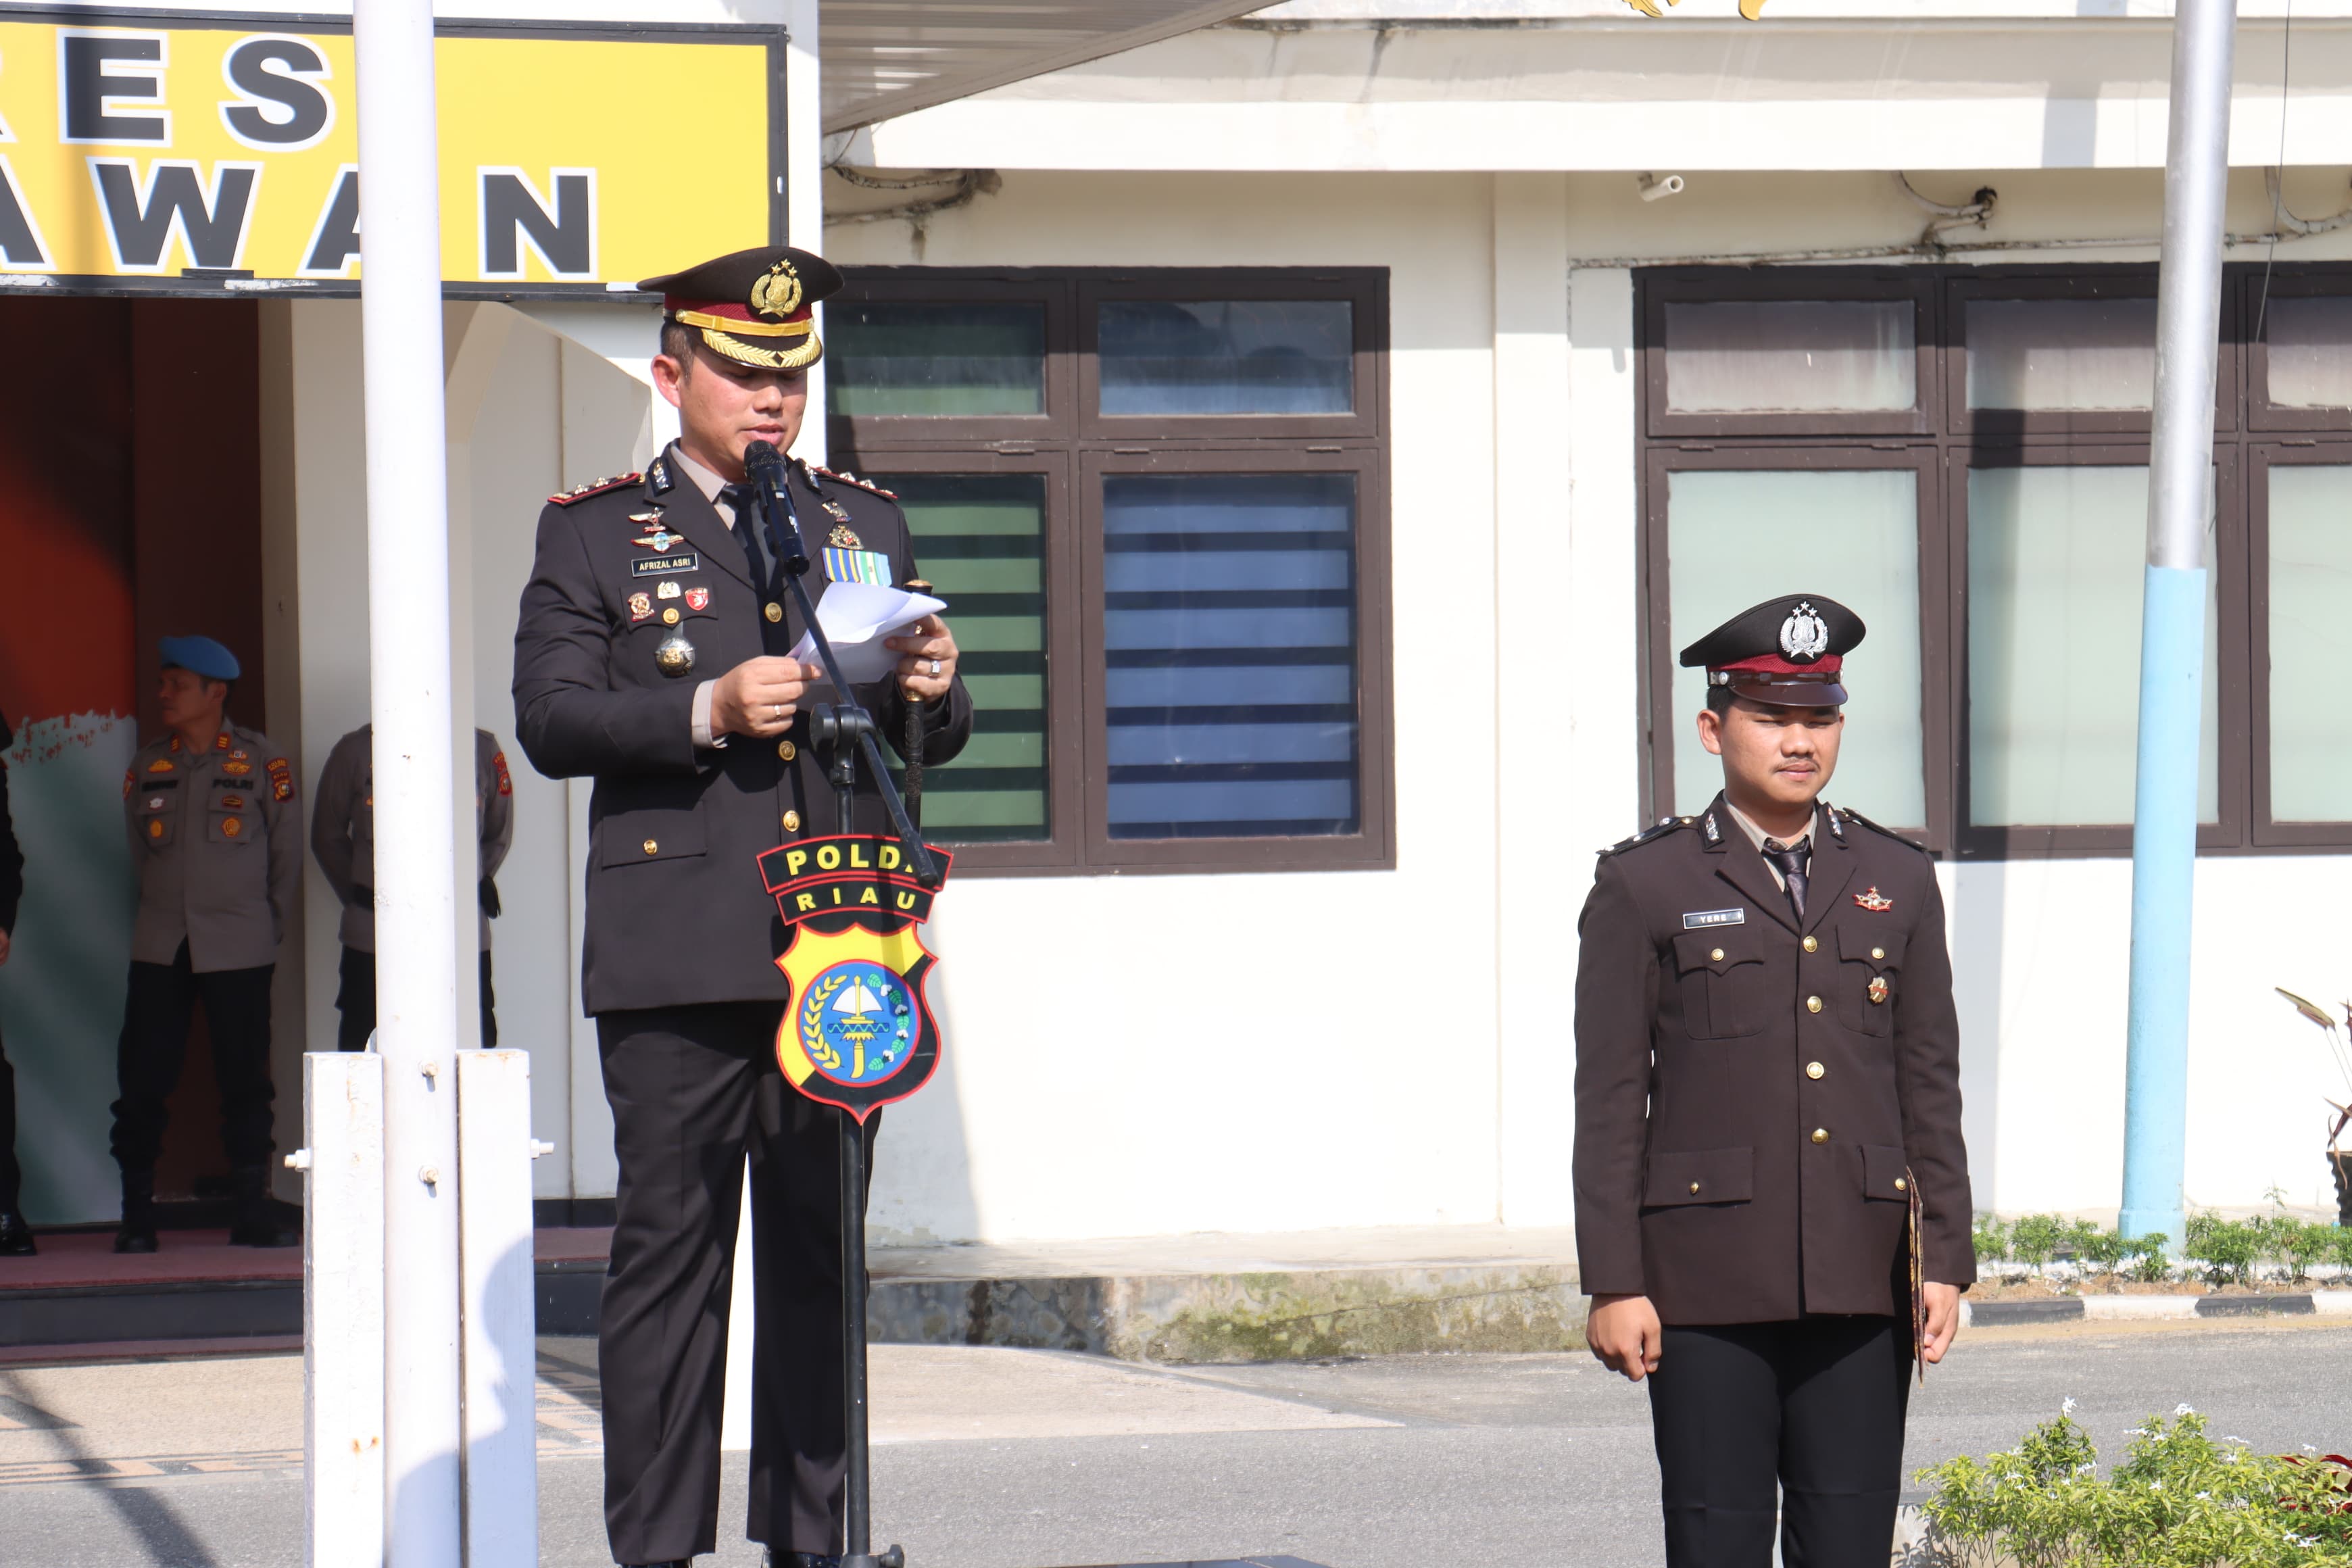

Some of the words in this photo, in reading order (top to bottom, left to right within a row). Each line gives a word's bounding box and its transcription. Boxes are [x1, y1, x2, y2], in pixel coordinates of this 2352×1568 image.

[0, 28, 335, 152] ES
[639, 560, 671, 571] AFRIZAL
[672, 558, 691, 568] ASRI
[212, 779, 253, 790] POLRI
[796, 887, 915, 912] RIAU
